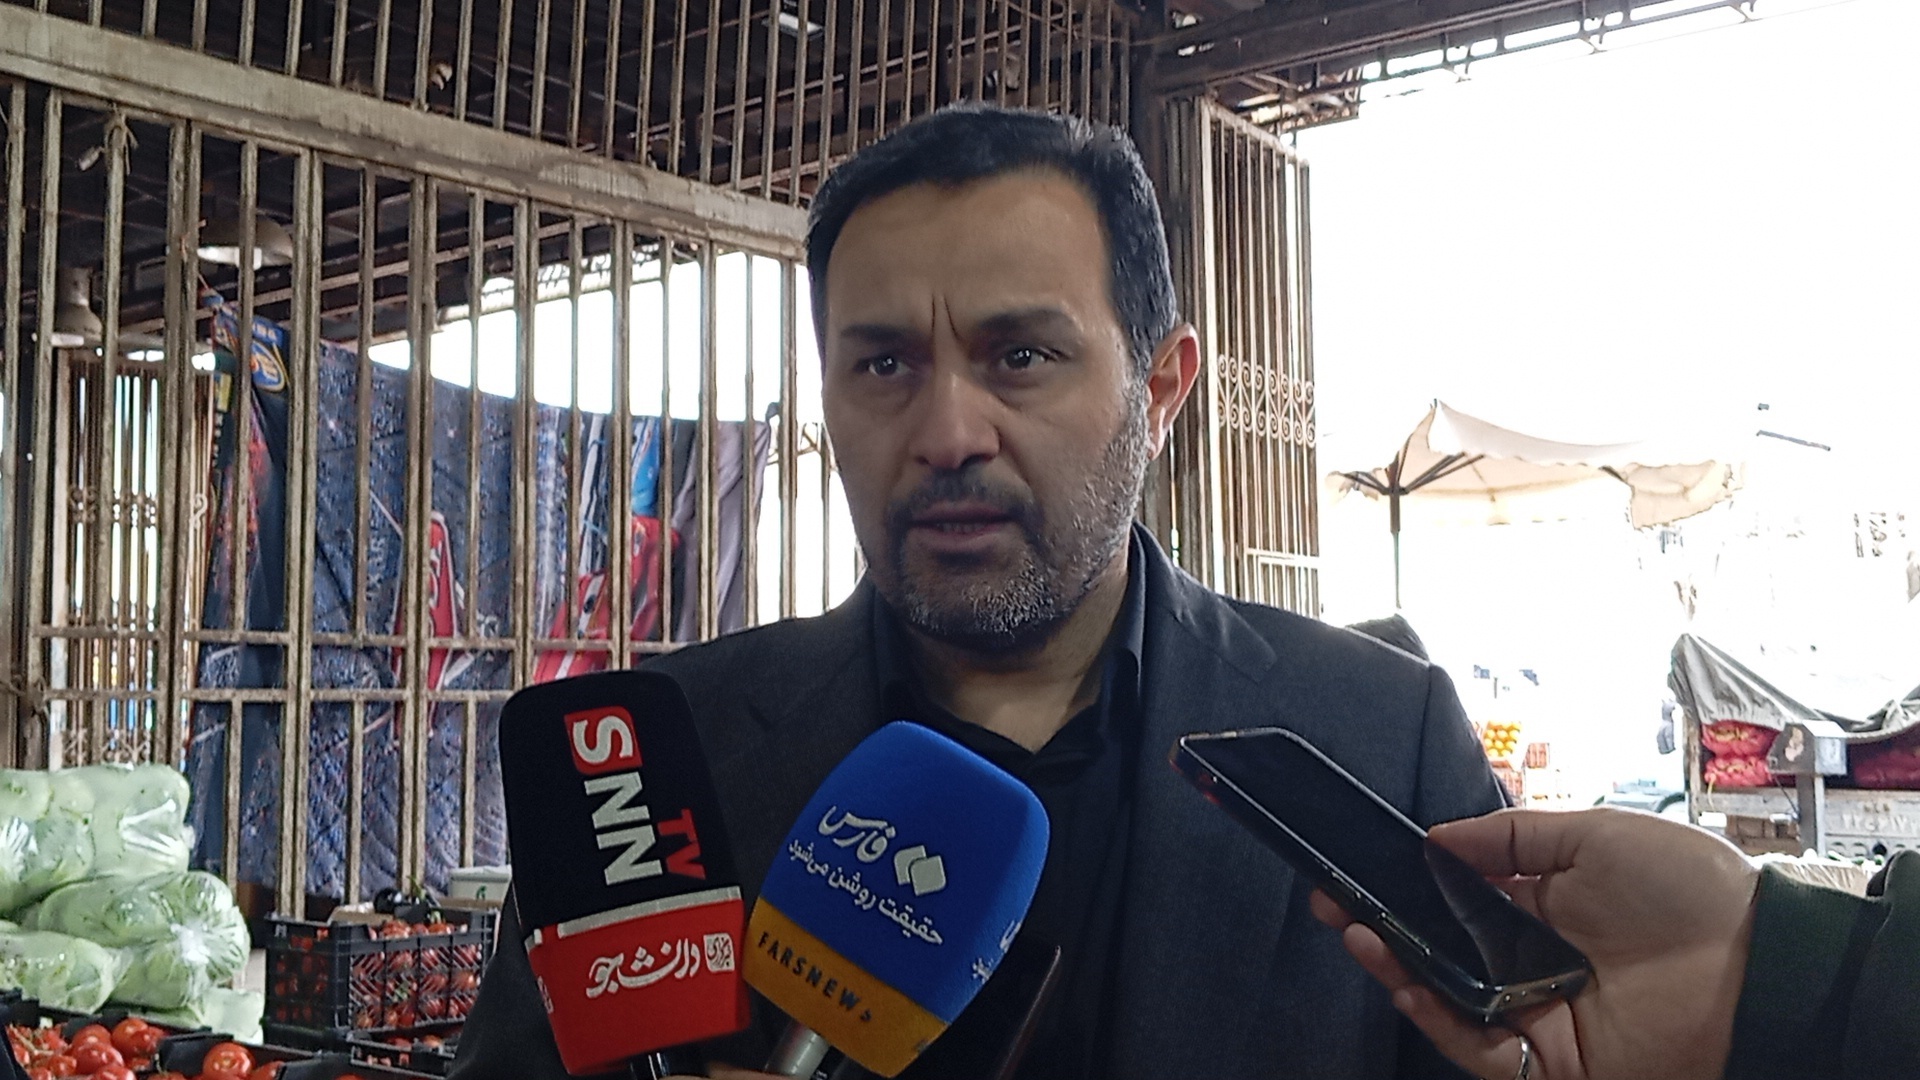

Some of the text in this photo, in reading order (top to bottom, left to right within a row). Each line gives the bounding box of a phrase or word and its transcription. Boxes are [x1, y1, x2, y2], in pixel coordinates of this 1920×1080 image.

[572, 715, 663, 885] SNN
[657, 808, 706, 880] TV
[818, 805, 896, 863] فارس
[828, 867, 876, 910] روشن
[878, 898, 943, 945] حقیقت
[586, 938, 700, 998] دانشجو
